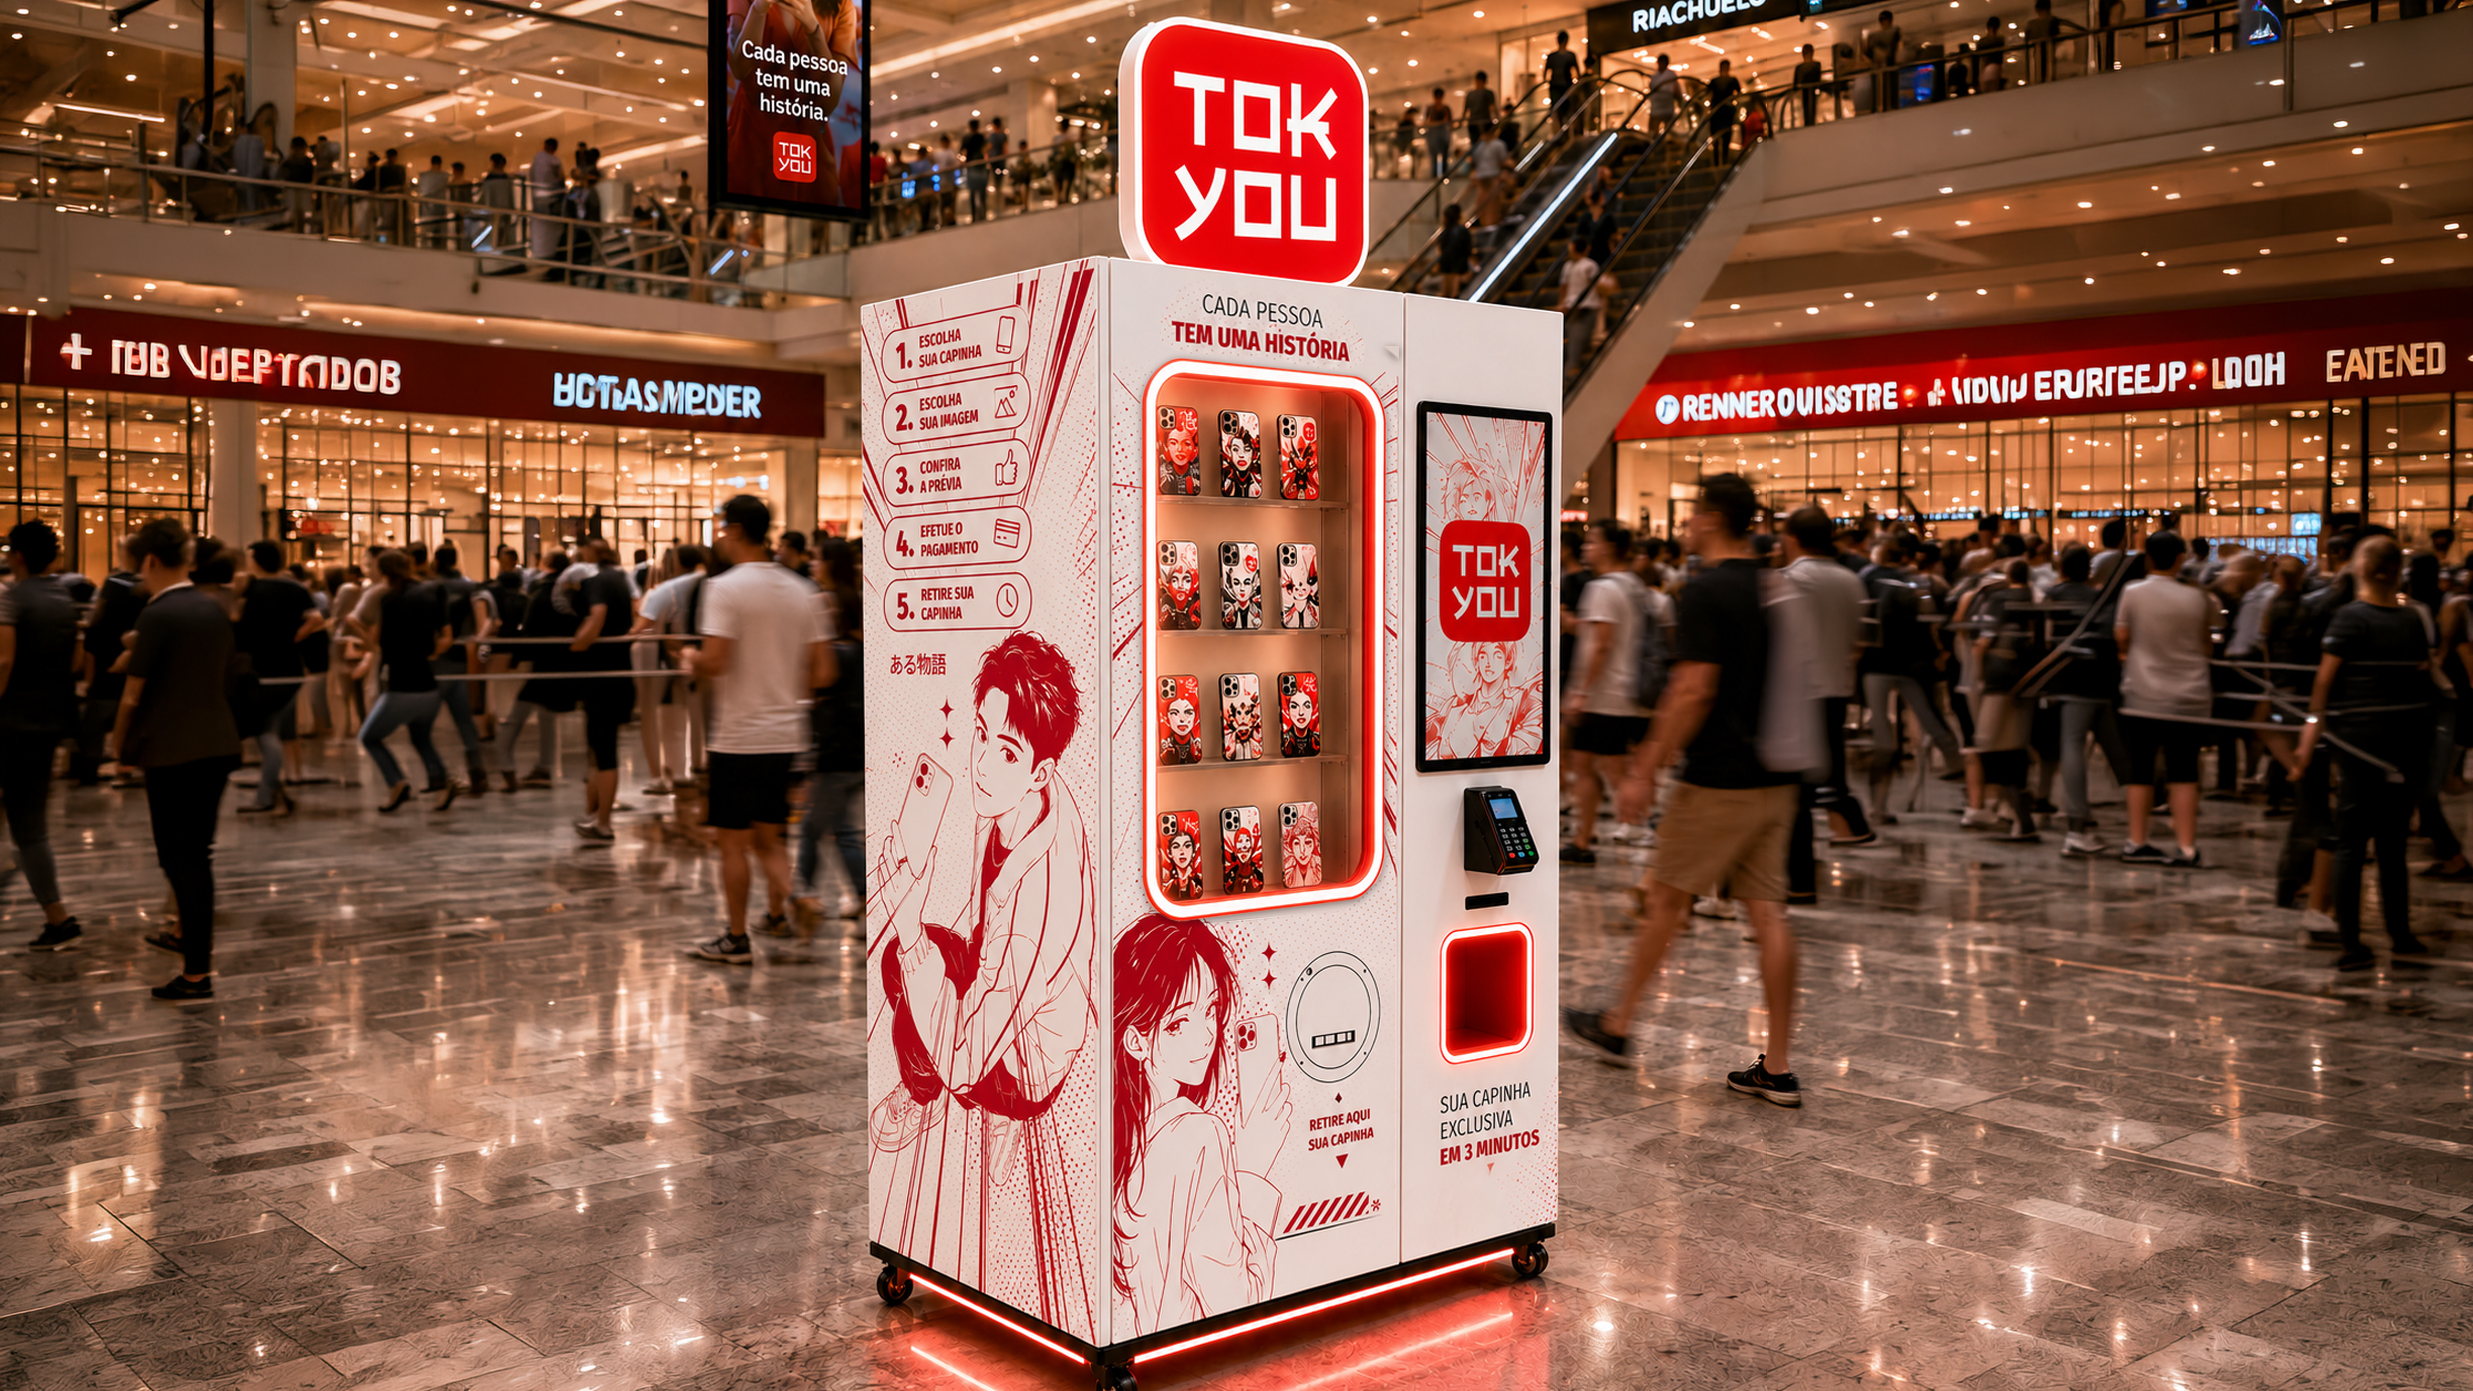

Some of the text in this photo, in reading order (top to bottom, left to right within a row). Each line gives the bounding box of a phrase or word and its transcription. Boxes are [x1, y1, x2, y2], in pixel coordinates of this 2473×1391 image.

[1633, 0, 1766, 33] RIACHUEL
[742, 40, 848, 75] Cada pessoa
[755, 68, 830, 97] tem uma
[760, 92, 829, 121] história.
[1174, 71, 1338, 160] TOK
[778, 142, 811, 160] TOK
[778, 157, 811, 174] YOU
[1174, 165, 1337, 241] YOU
[1202, 294, 1323, 328] CADA PESSOA
[919, 328, 961, 349] ESCOLHA
[1171, 320, 1213, 346] TEM
[1218, 326, 1261, 351] UMA
[895, 342, 913, 369] 1.
[919, 344, 982, 368] SUA CAPINHA
[919, 392, 962, 411] ESCOLHA
[895, 403, 914, 432] 2.
[919, 409, 979, 430] SUA IMAGEM
[920, 457, 961, 474] CONFIRA
[895, 466, 914, 494] 3.
[920, 474, 962, 493] A PRÉVIA
[920, 521, 963, 538] EFETUE O
[896, 530, 914, 557] 4.
[920, 540, 979, 557] PAGAMENTO
[1452, 544, 1519, 578] TOK
[896, 592, 915, 620] 5.
[921, 586, 974, 601] RETIRE SUA
[1452, 586, 1519, 620] YOU
[921, 606, 963, 620] CAPINHA
[890, 653, 946, 675] ある物語
[1440, 1081, 1531, 1114] SUA CAPINHA
[1309, 1108, 1371, 1131] RETIRE AQUI
[1441, 1109, 1513, 1140] EXCLUSIVA
[1308, 1127, 1374, 1151] SUA CAPINHA
[1440, 1129, 1540, 1166] EM 3 MINUTOS
